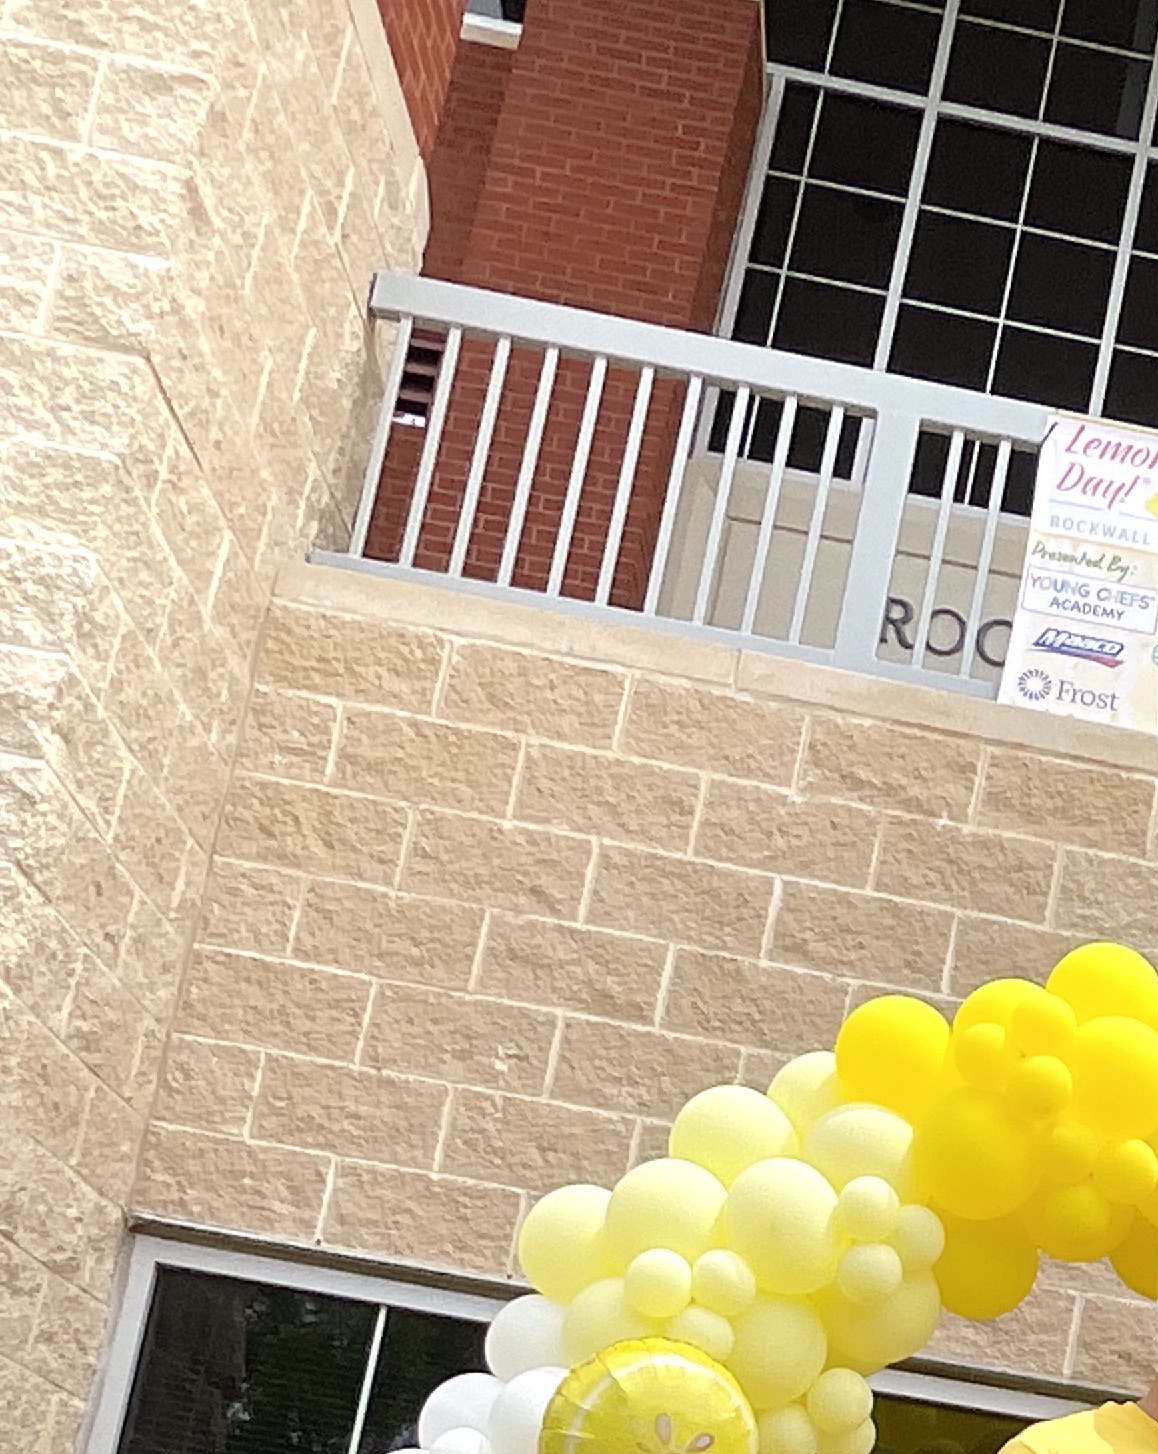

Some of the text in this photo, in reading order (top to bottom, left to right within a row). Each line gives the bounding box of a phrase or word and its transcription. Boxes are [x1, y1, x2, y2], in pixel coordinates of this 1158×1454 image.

[1056, 461, 1140, 510] Day!
[1050, 515, 1151, 546] ROCKWALL
[1031, 540, 1139, 583] Presented By:
[1029, 573, 1151, 610] YOUNG CHEFS
[1049, 596, 1126, 621] ACADEMY
[1032, 627, 1125, 657] Maaco
[1056, 679, 1120, 711] Frost
